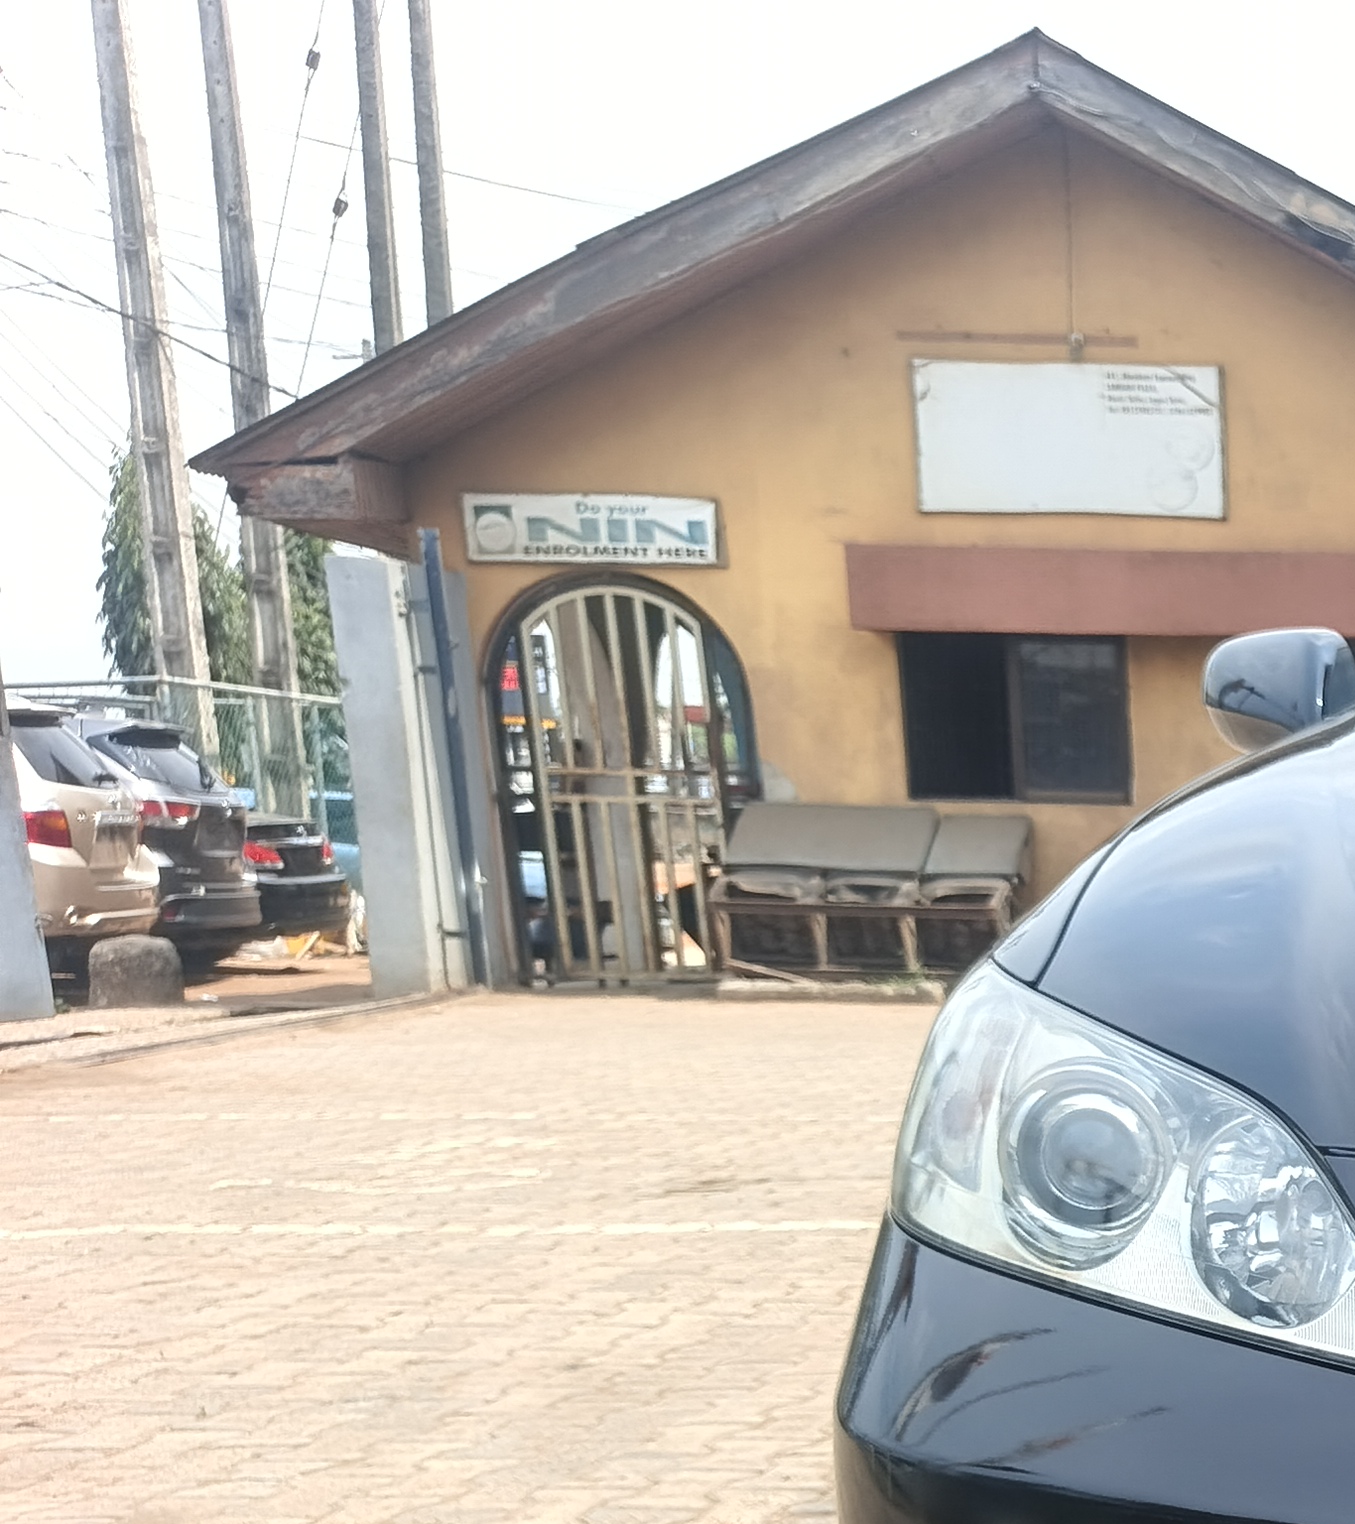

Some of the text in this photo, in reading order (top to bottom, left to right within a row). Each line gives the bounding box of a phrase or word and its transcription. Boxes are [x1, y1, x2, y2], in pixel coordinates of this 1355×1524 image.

[575, 501, 650, 518] Do your
[526, 517, 709, 545] NIN
[523, 544, 709, 559] ENROLMENT HERE
